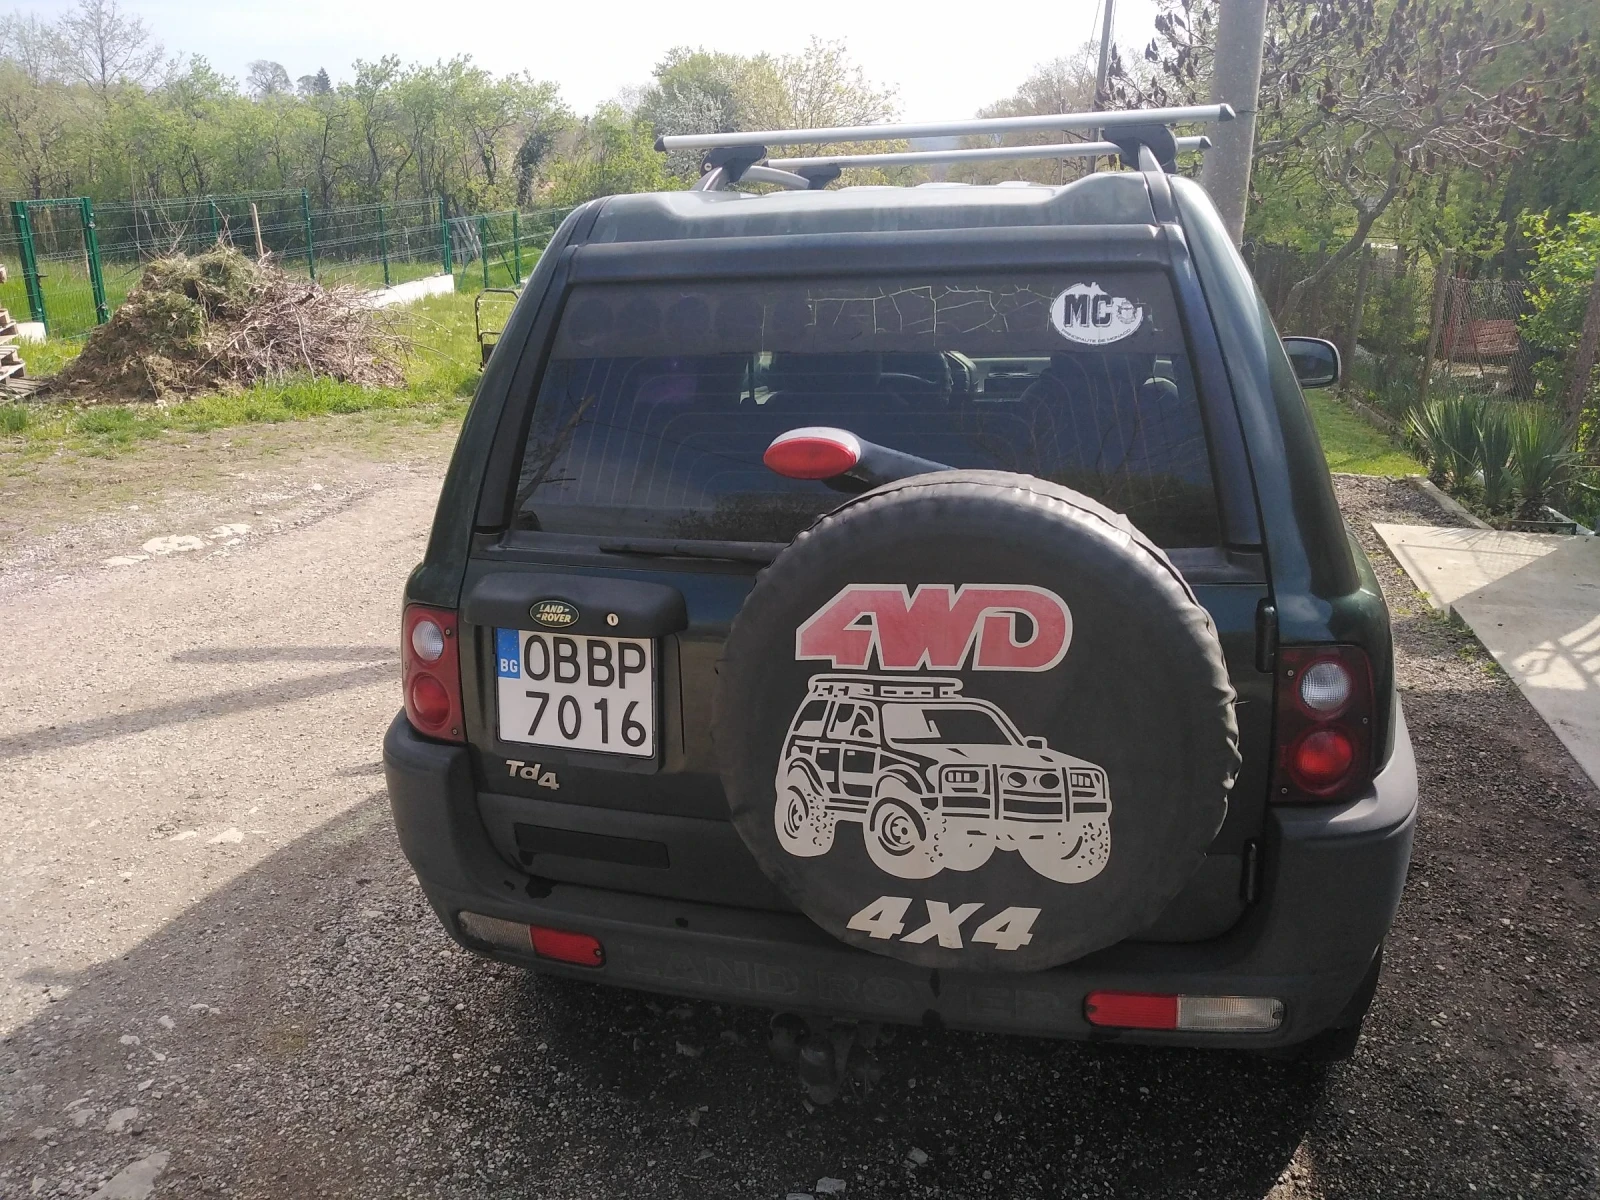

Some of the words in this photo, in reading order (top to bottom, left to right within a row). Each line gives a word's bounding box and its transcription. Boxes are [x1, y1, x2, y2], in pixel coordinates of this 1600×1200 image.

[539, 604, 564, 613] LAND
[540, 612, 571, 623] ROVER
[795, 583, 1074, 672] 4WD
[500, 658, 518, 673] BG
[525, 690, 647, 747] 7016
[506, 759, 560, 790] Td4
[846, 895, 1042, 950] 4X4
[620, 944, 799, 997] LAND
